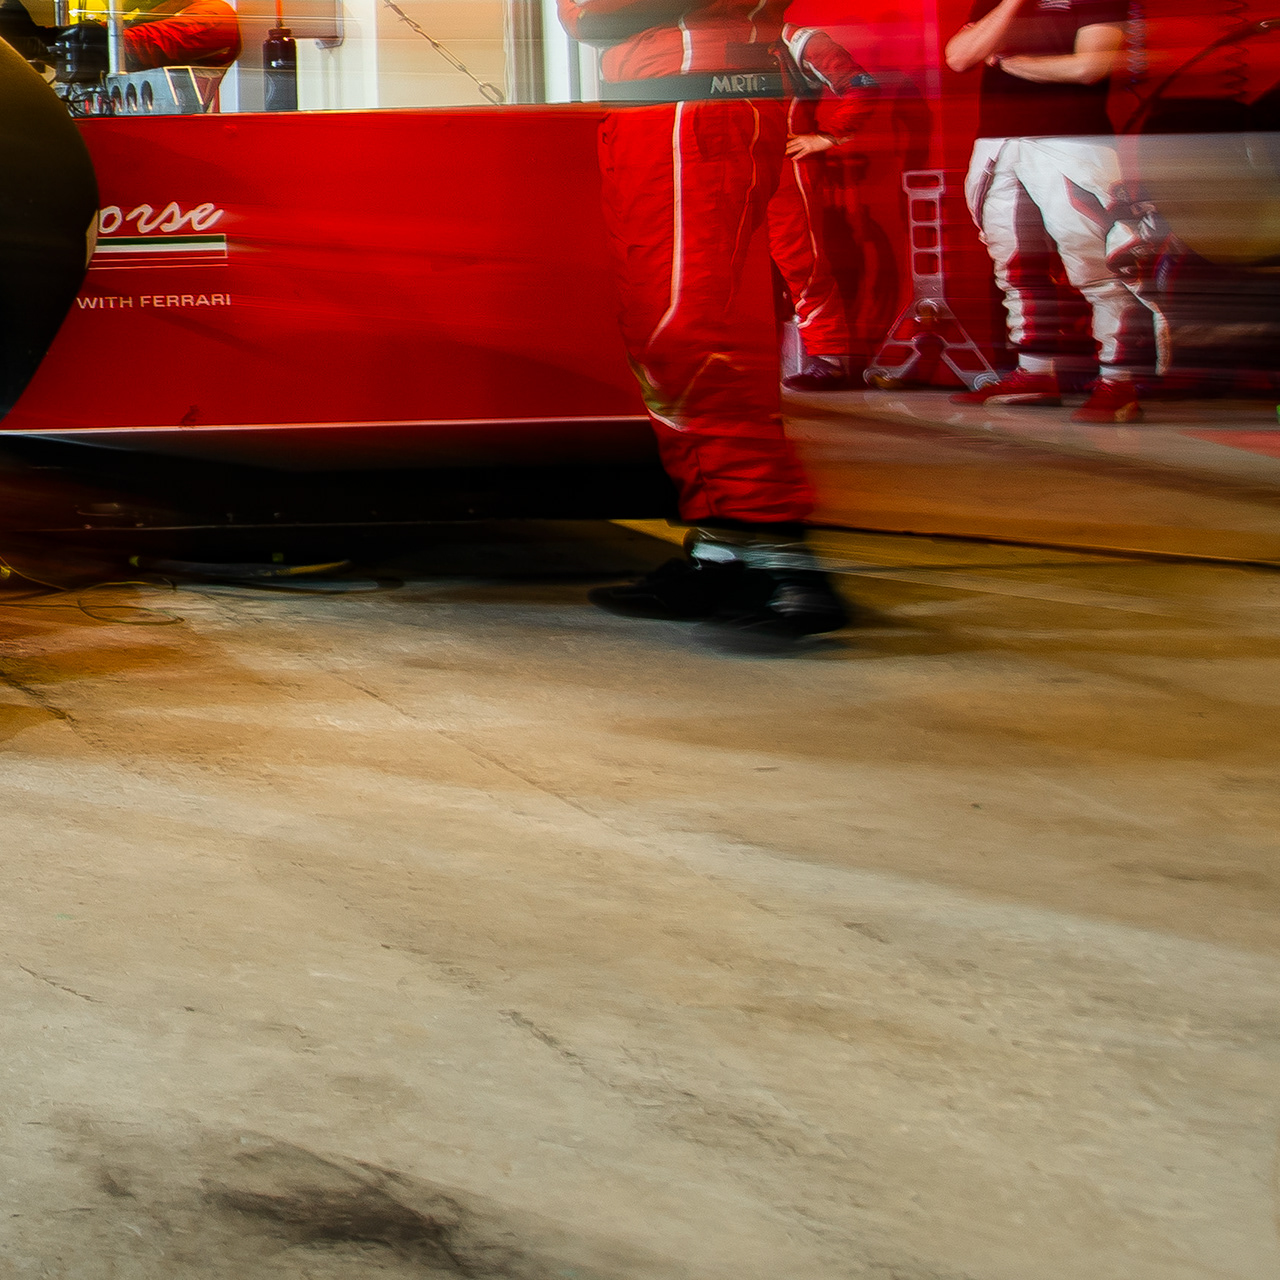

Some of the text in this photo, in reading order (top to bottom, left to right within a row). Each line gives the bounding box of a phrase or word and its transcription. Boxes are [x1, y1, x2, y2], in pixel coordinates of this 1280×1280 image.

[97, 201, 225, 234] orse
[76, 293, 232, 310] WITH FERRARI
